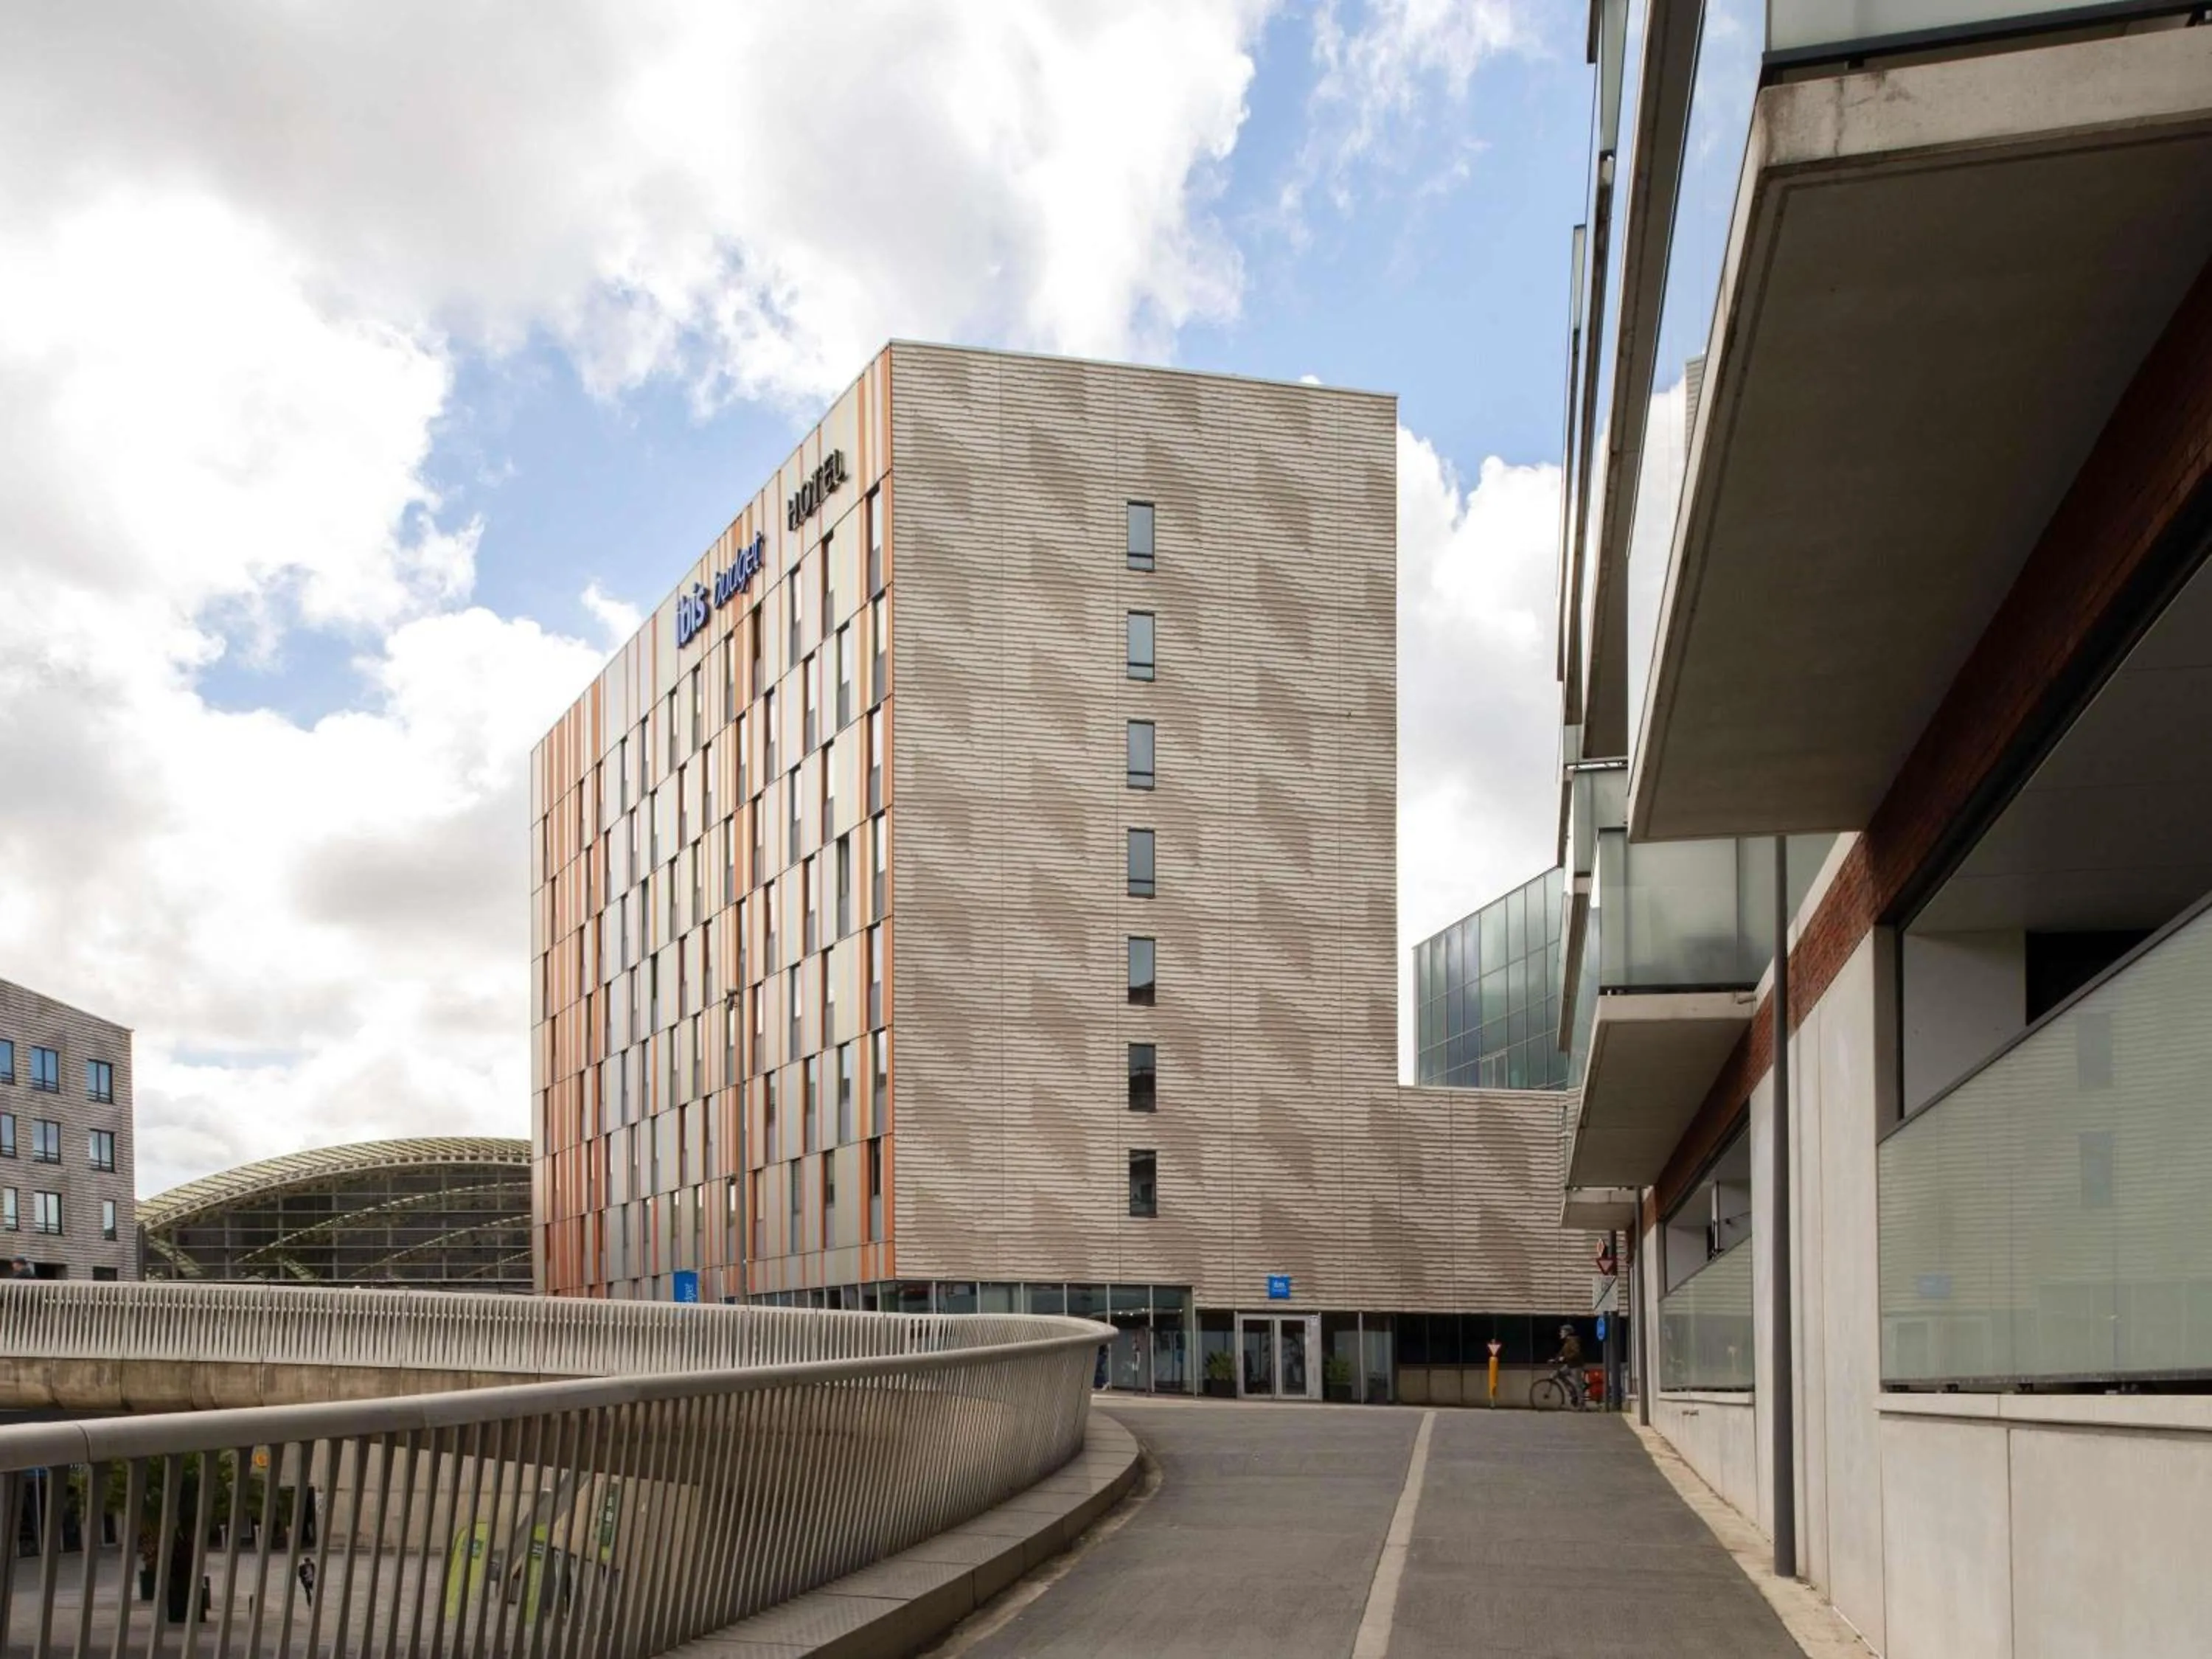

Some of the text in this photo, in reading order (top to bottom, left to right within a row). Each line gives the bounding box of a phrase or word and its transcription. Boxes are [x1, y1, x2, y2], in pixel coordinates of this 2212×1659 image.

[677, 448, 849, 649] ibis budget HOTEL
